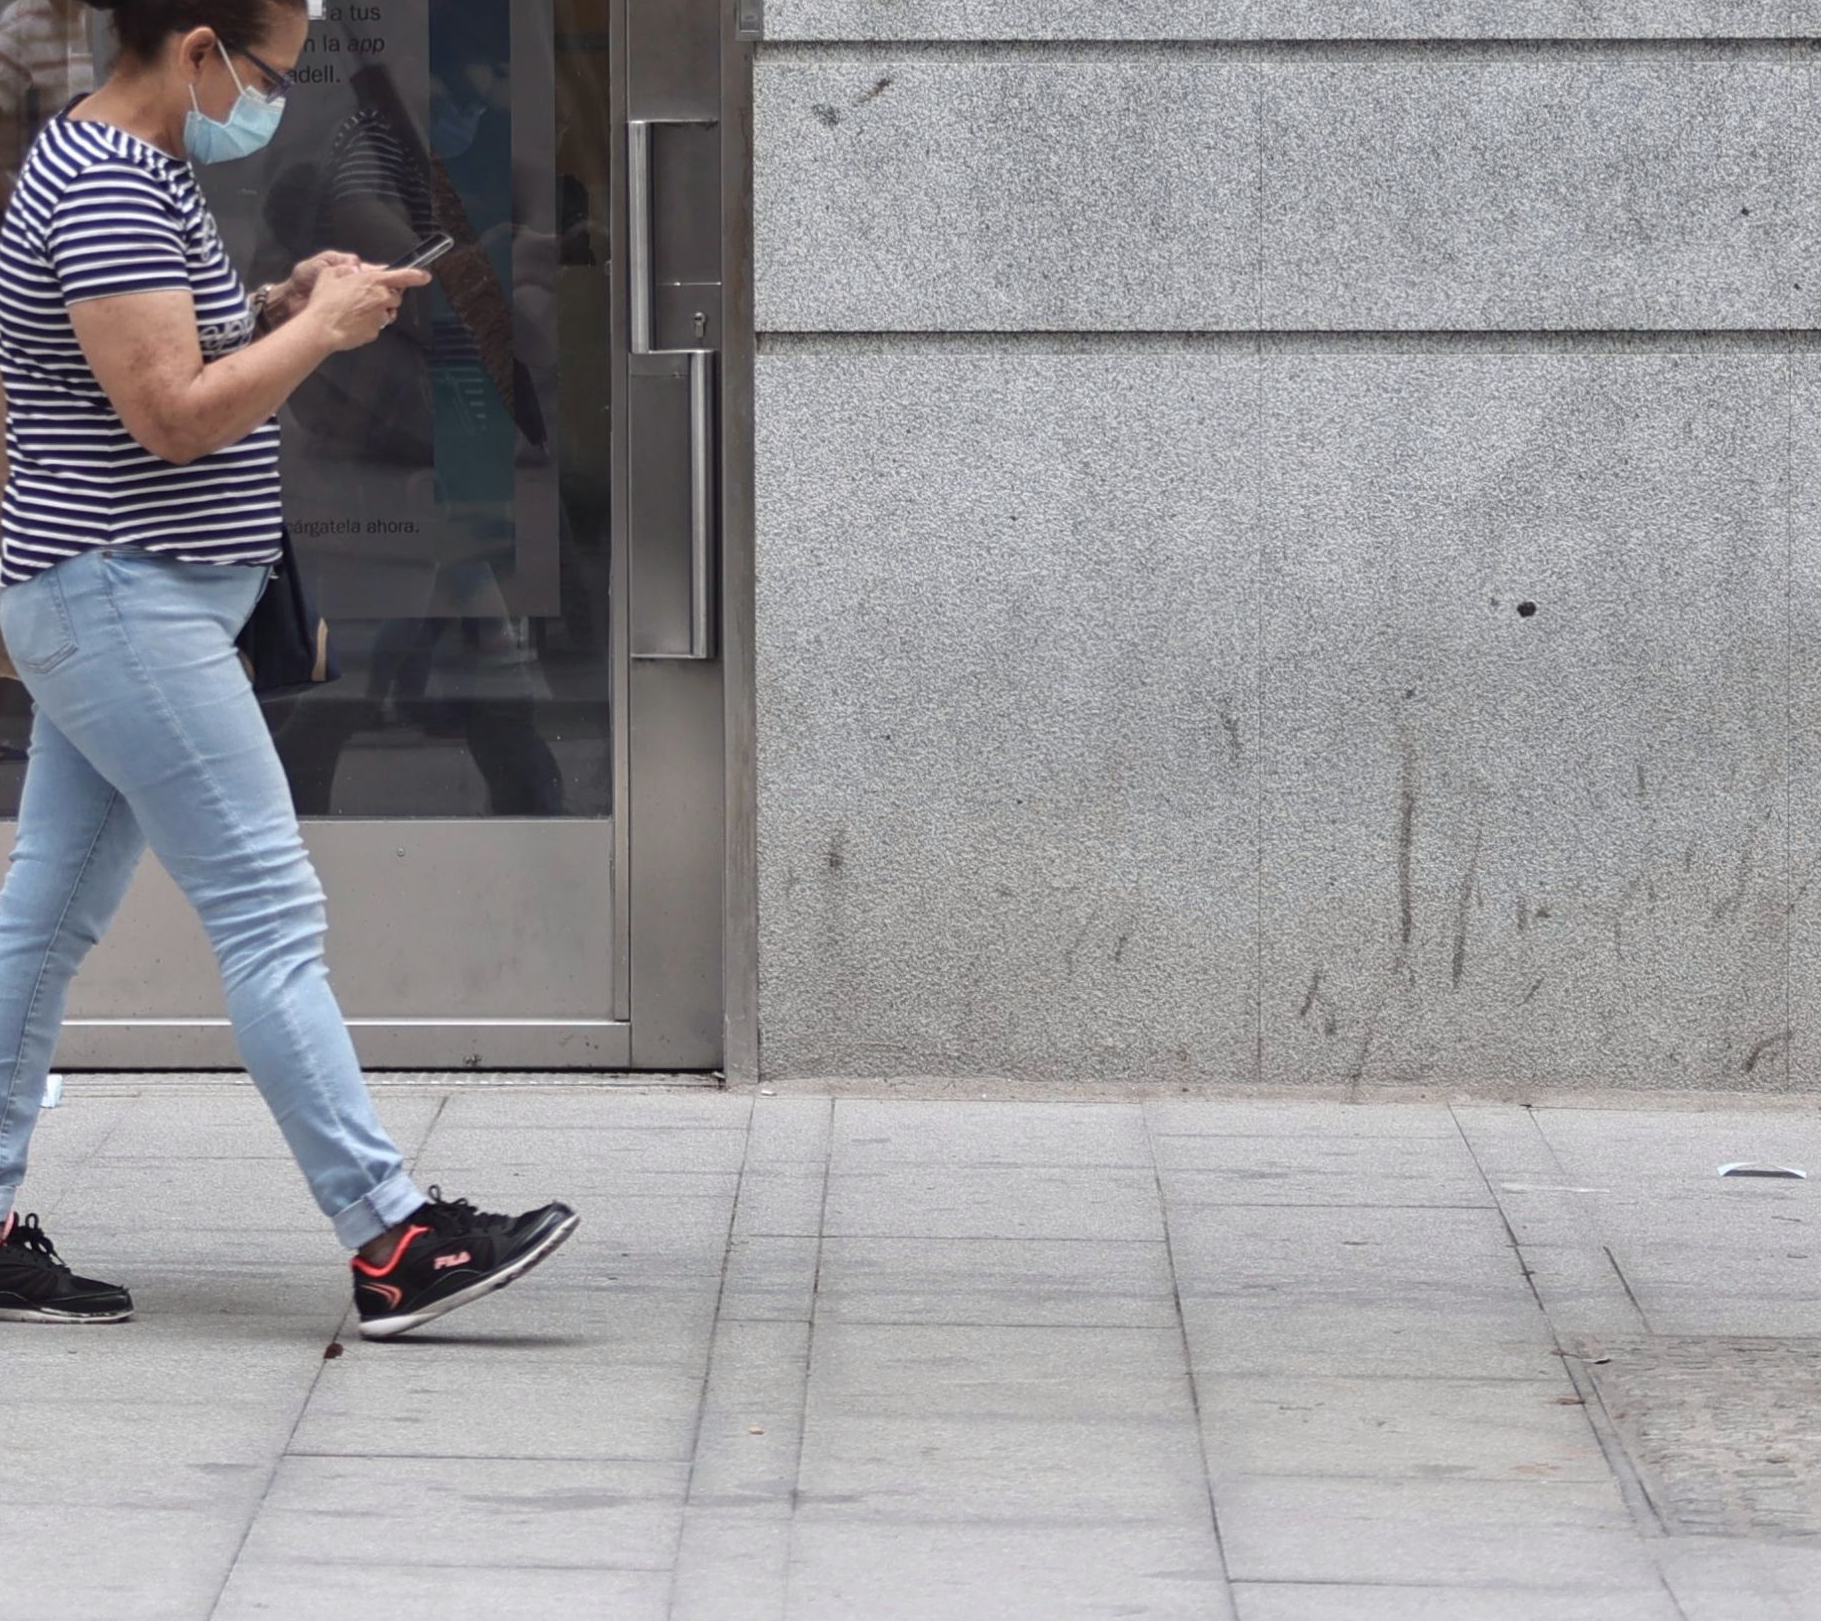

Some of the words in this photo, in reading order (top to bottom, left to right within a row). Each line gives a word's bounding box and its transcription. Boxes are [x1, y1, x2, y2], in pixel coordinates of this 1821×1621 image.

[350, 4, 381, 21] tus
[323, 34, 340, 52] la
[347, 36, 385, 56] app
[287, 64, 341, 84] adell.
[287, 519, 361, 538] cárgatela
[366, 519, 420, 534] ahora.
[434, 1251, 471, 1270] FILA
